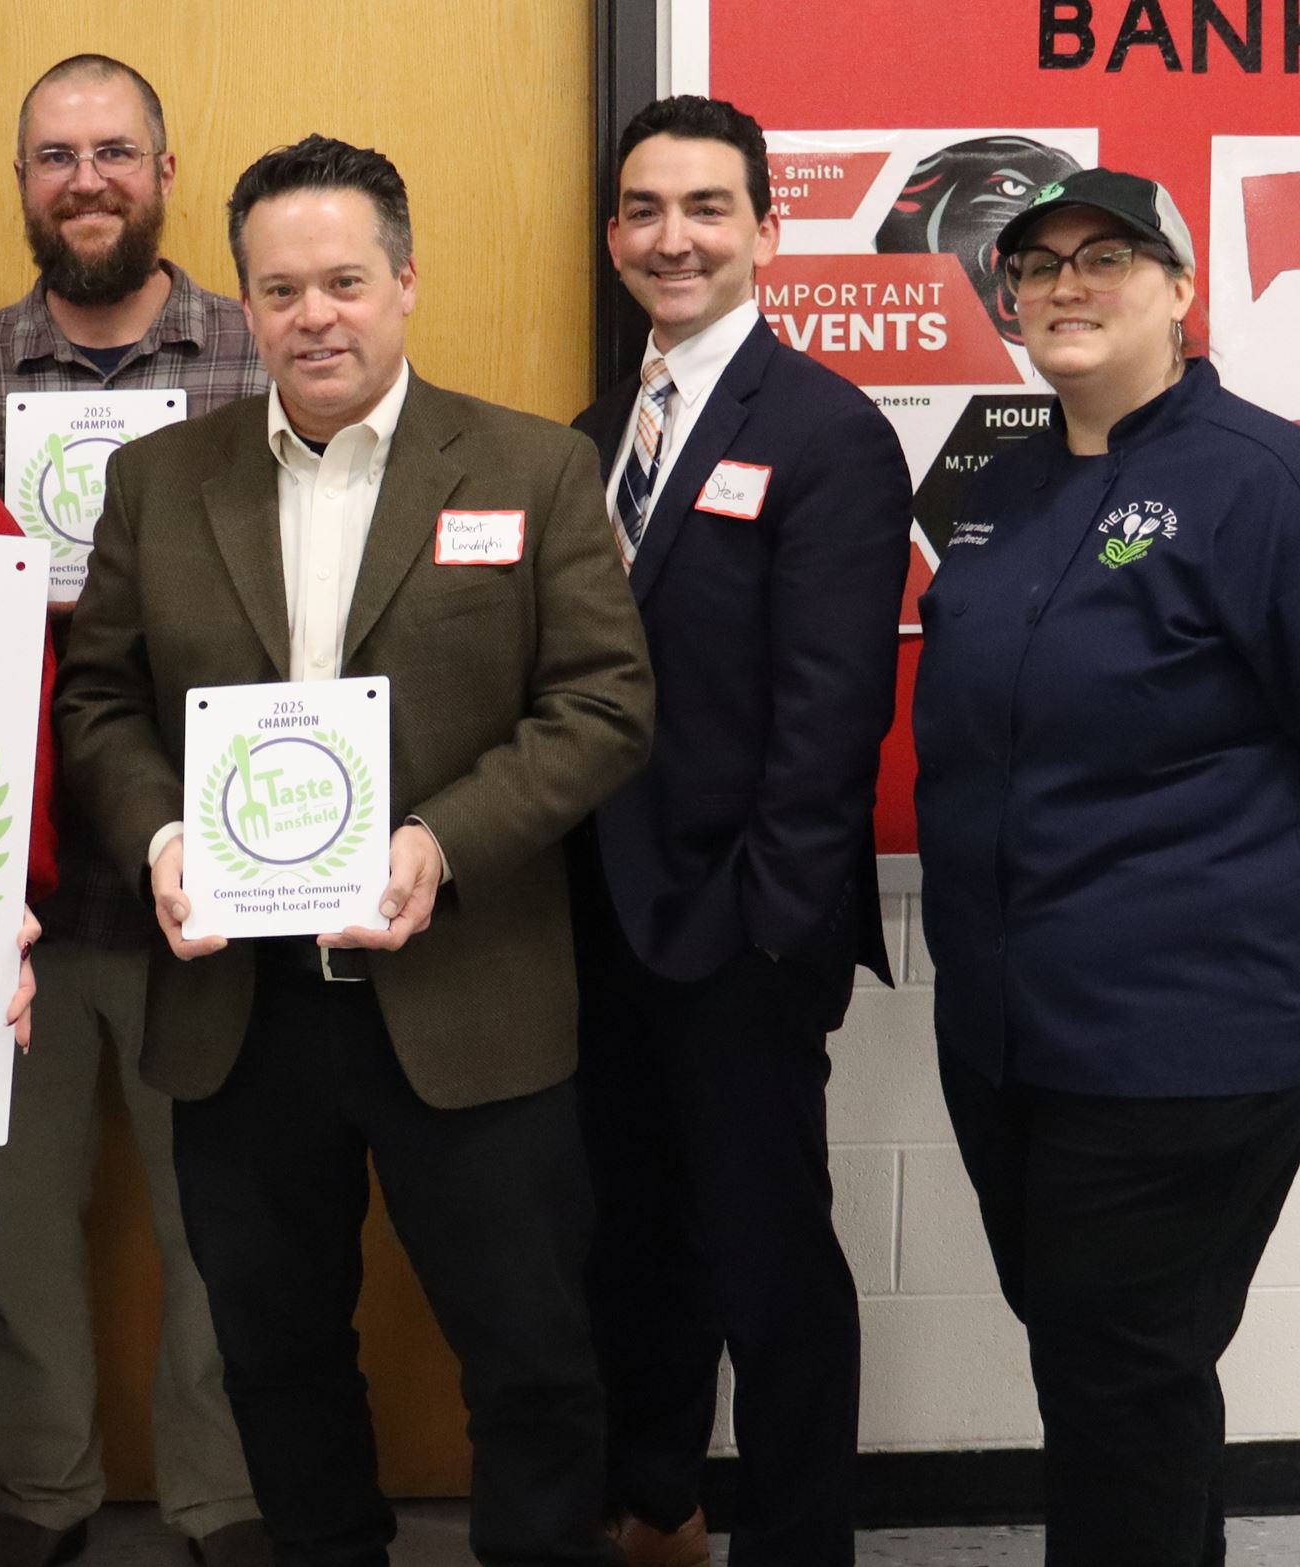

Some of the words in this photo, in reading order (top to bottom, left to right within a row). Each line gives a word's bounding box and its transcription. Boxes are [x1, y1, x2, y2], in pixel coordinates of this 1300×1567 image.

[1039, 0, 1300, 73] BAN
[785, 165, 844, 179] Smith
[755, 283, 944, 307] IMPORTANT
[874, 396, 930, 406] chestra
[84, 407, 112, 418] 2025
[986, 408, 1050, 427] HOUR
[70, 420, 125, 430] CHAMPION
[705, 473, 745, 500] Steve
[448, 517, 489, 533] Robert
[1098, 503, 1139, 533] FIELD
[1144, 501, 1163, 513] TO
[1161, 508, 1178, 539] TRAY
[50, 564, 86, 574] necting
[50, 577, 86, 587] Throug
[273, 701, 304, 714] 2025
[257, 715, 319, 729] CHAMPION
[253, 768, 333, 807] Taste
[213, 887, 275, 900] Connecting
[277, 886, 296, 896] the
[297, 883, 362, 895] Community
[234, 902, 280, 914] Through
[282, 900, 311, 910] Local
[313, 899, 340, 910] Food
